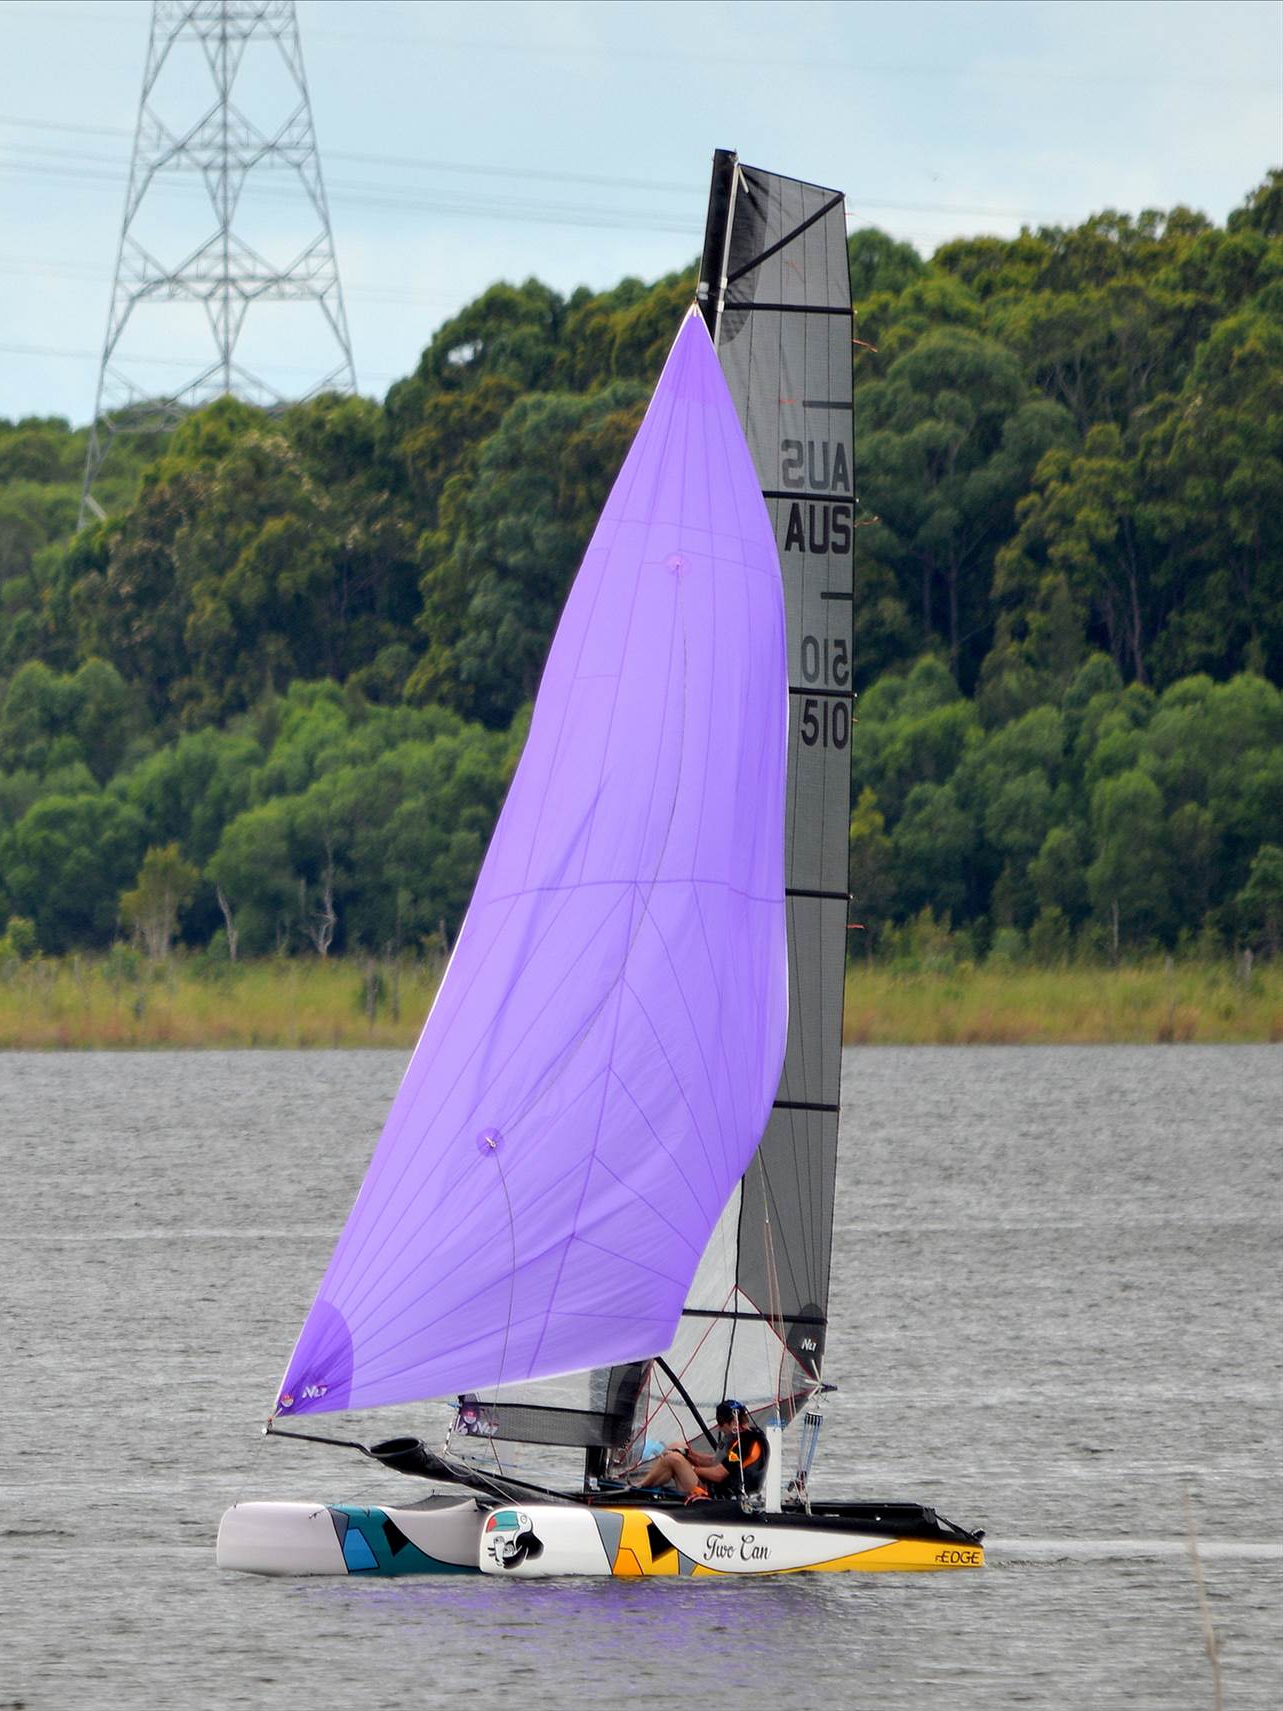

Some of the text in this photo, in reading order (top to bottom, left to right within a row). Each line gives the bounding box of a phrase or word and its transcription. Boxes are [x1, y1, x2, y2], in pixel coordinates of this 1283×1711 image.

[784, 503, 851, 554] AUS
[801, 699, 849, 750] 510
[703, 1533, 772, 1561] Two Can
